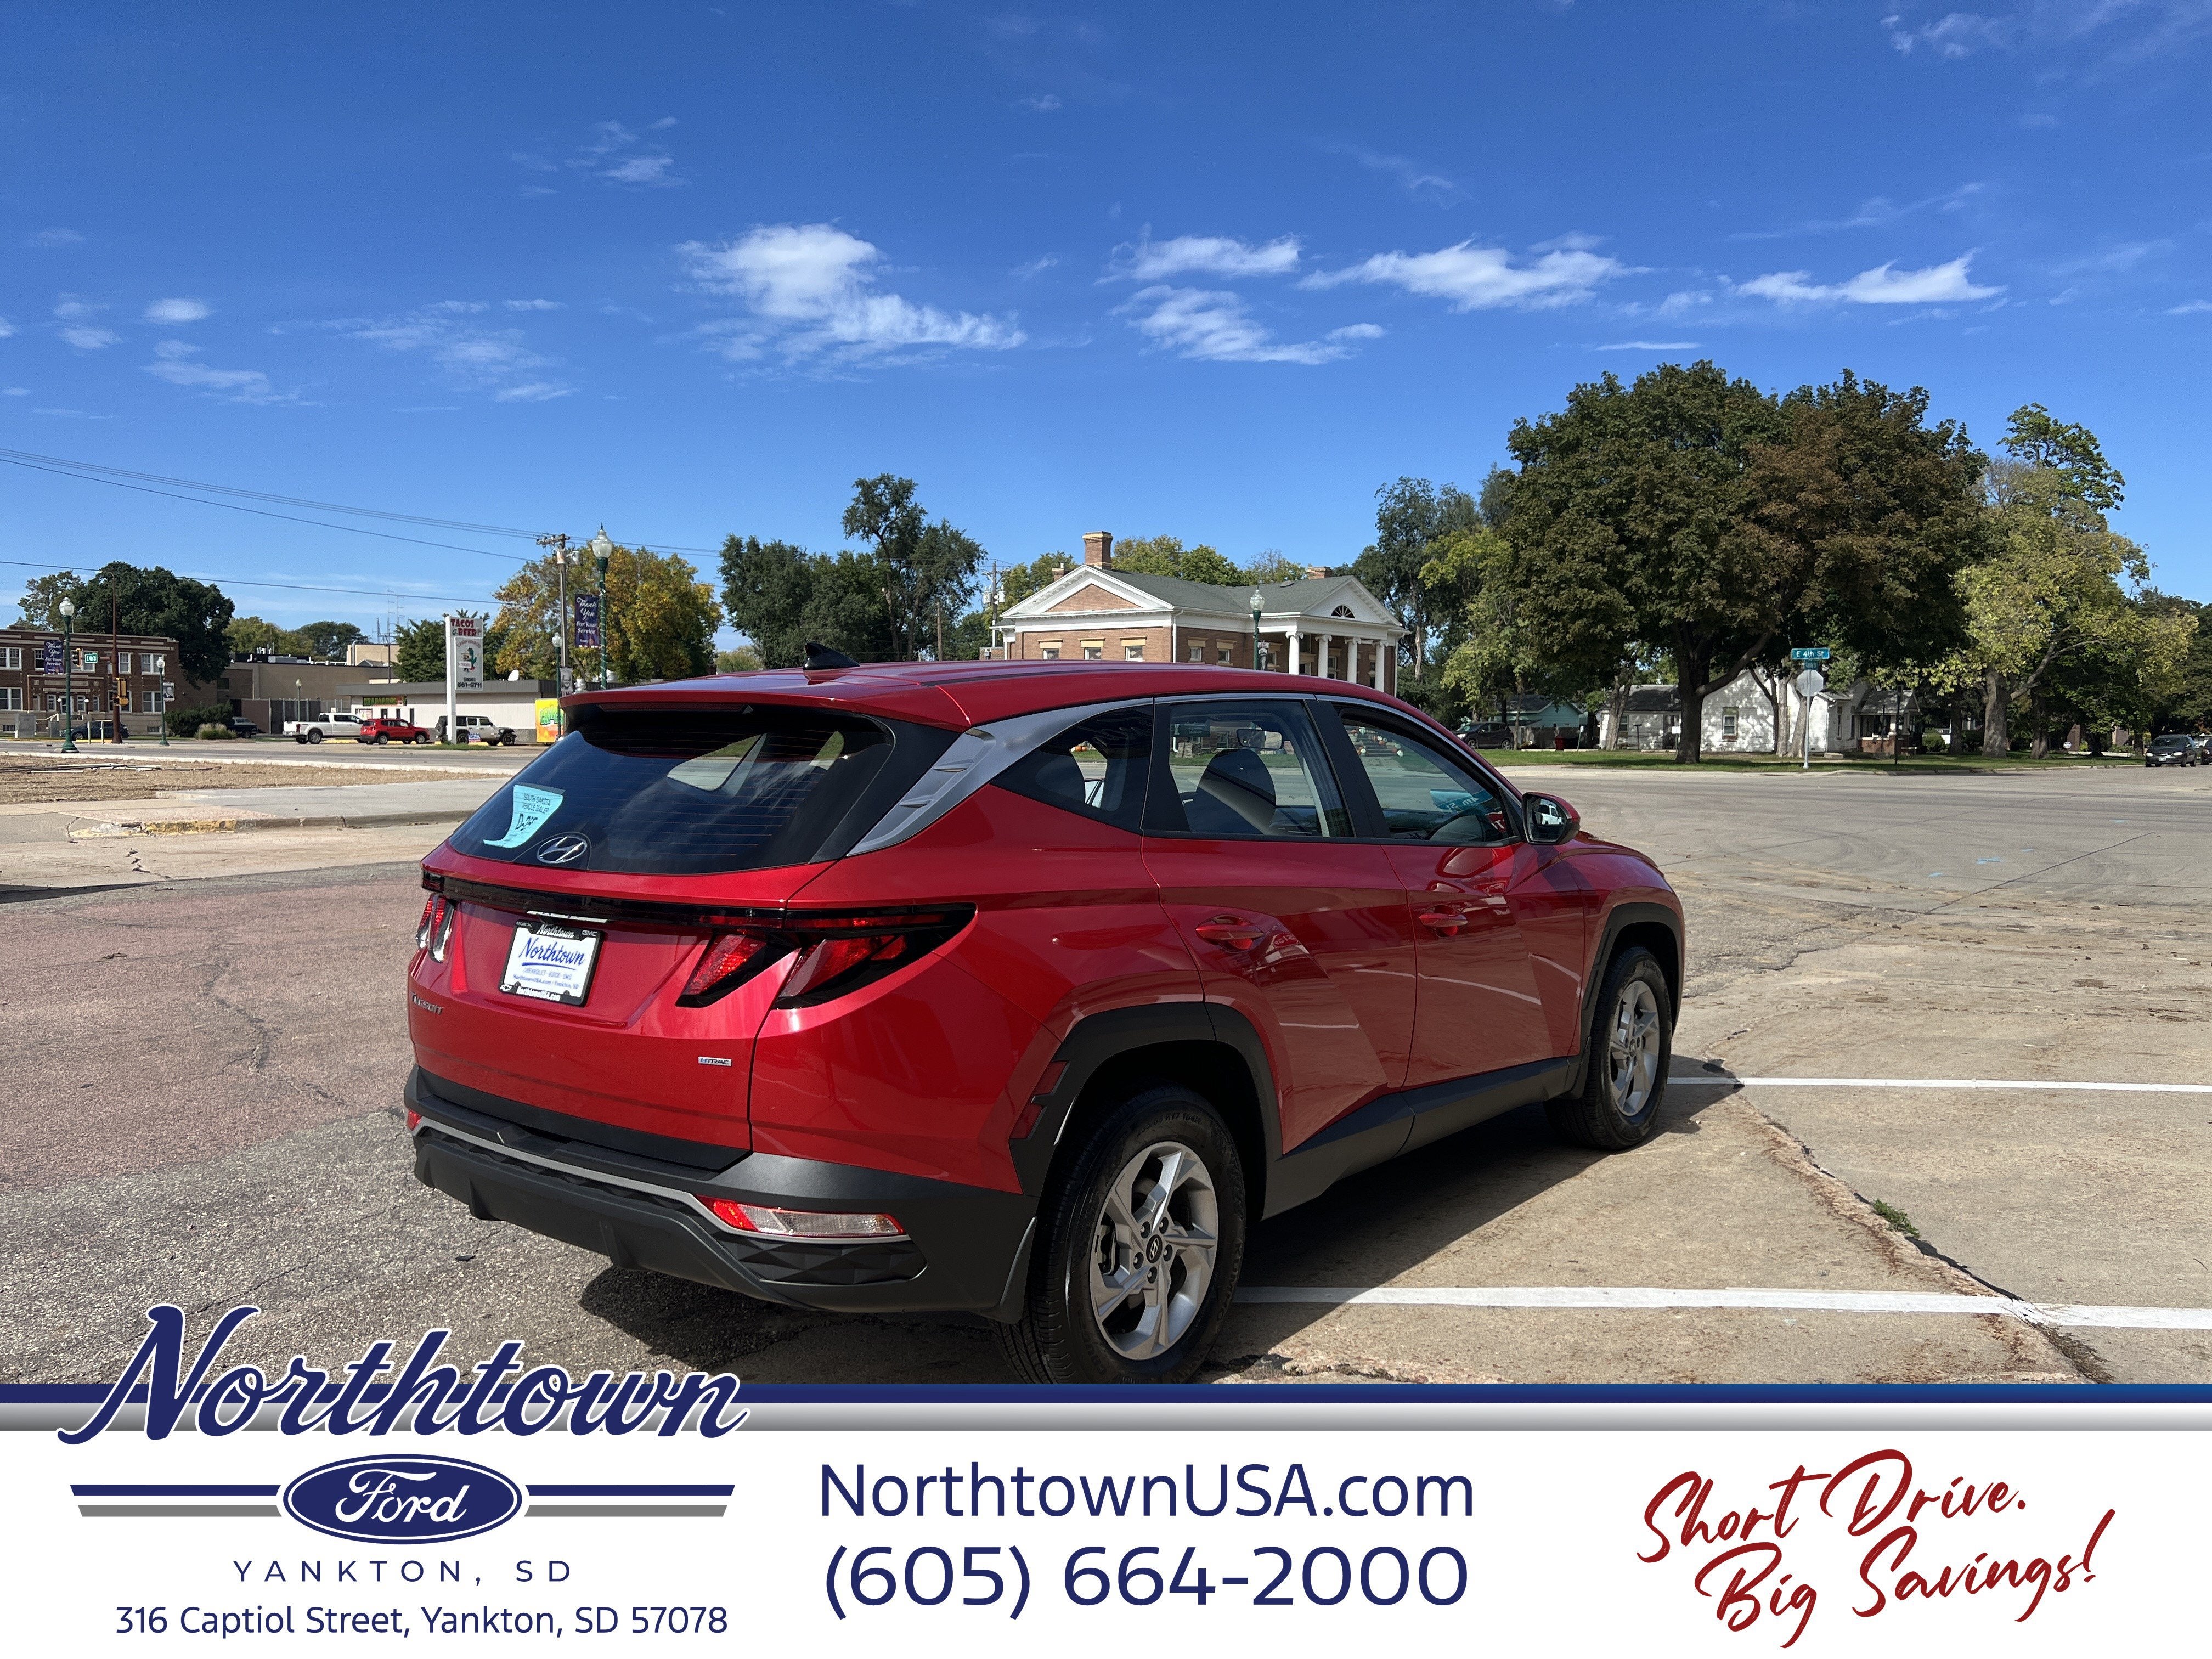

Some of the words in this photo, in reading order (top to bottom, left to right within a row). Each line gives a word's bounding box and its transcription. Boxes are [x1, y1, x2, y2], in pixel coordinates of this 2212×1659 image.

[577, 597, 597, 607] Thank
[580, 608, 595, 620] You
[450, 619, 474, 628] TACOS
[458, 628, 476, 636] BEER
[536, 924, 574, 938] Northtown
[518, 937, 585, 965] Northtown
